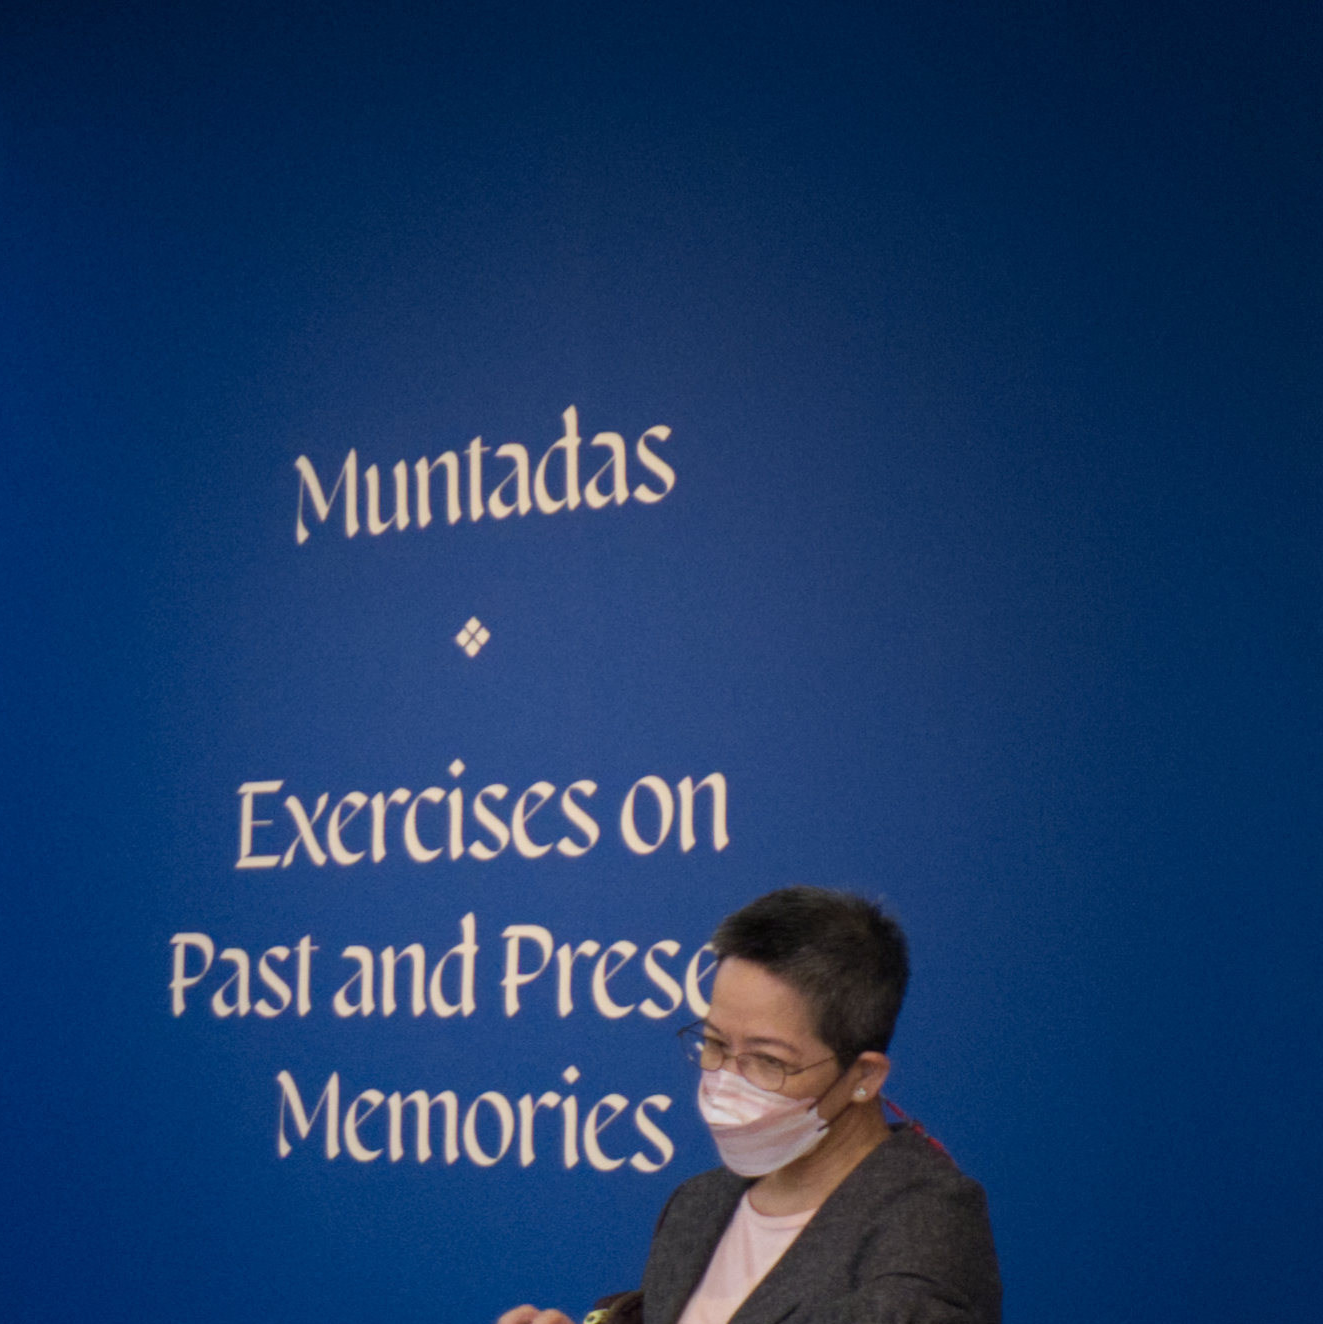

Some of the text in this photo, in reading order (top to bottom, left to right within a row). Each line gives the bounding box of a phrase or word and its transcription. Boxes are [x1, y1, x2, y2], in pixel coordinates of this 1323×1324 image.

[294, 404, 677, 545] Muntadas
[235, 758, 730, 869] Exercises on
[168, 932, 319, 1018] Past
[332, 911, 480, 1019] and
[276, 1065, 675, 1173] Memories
